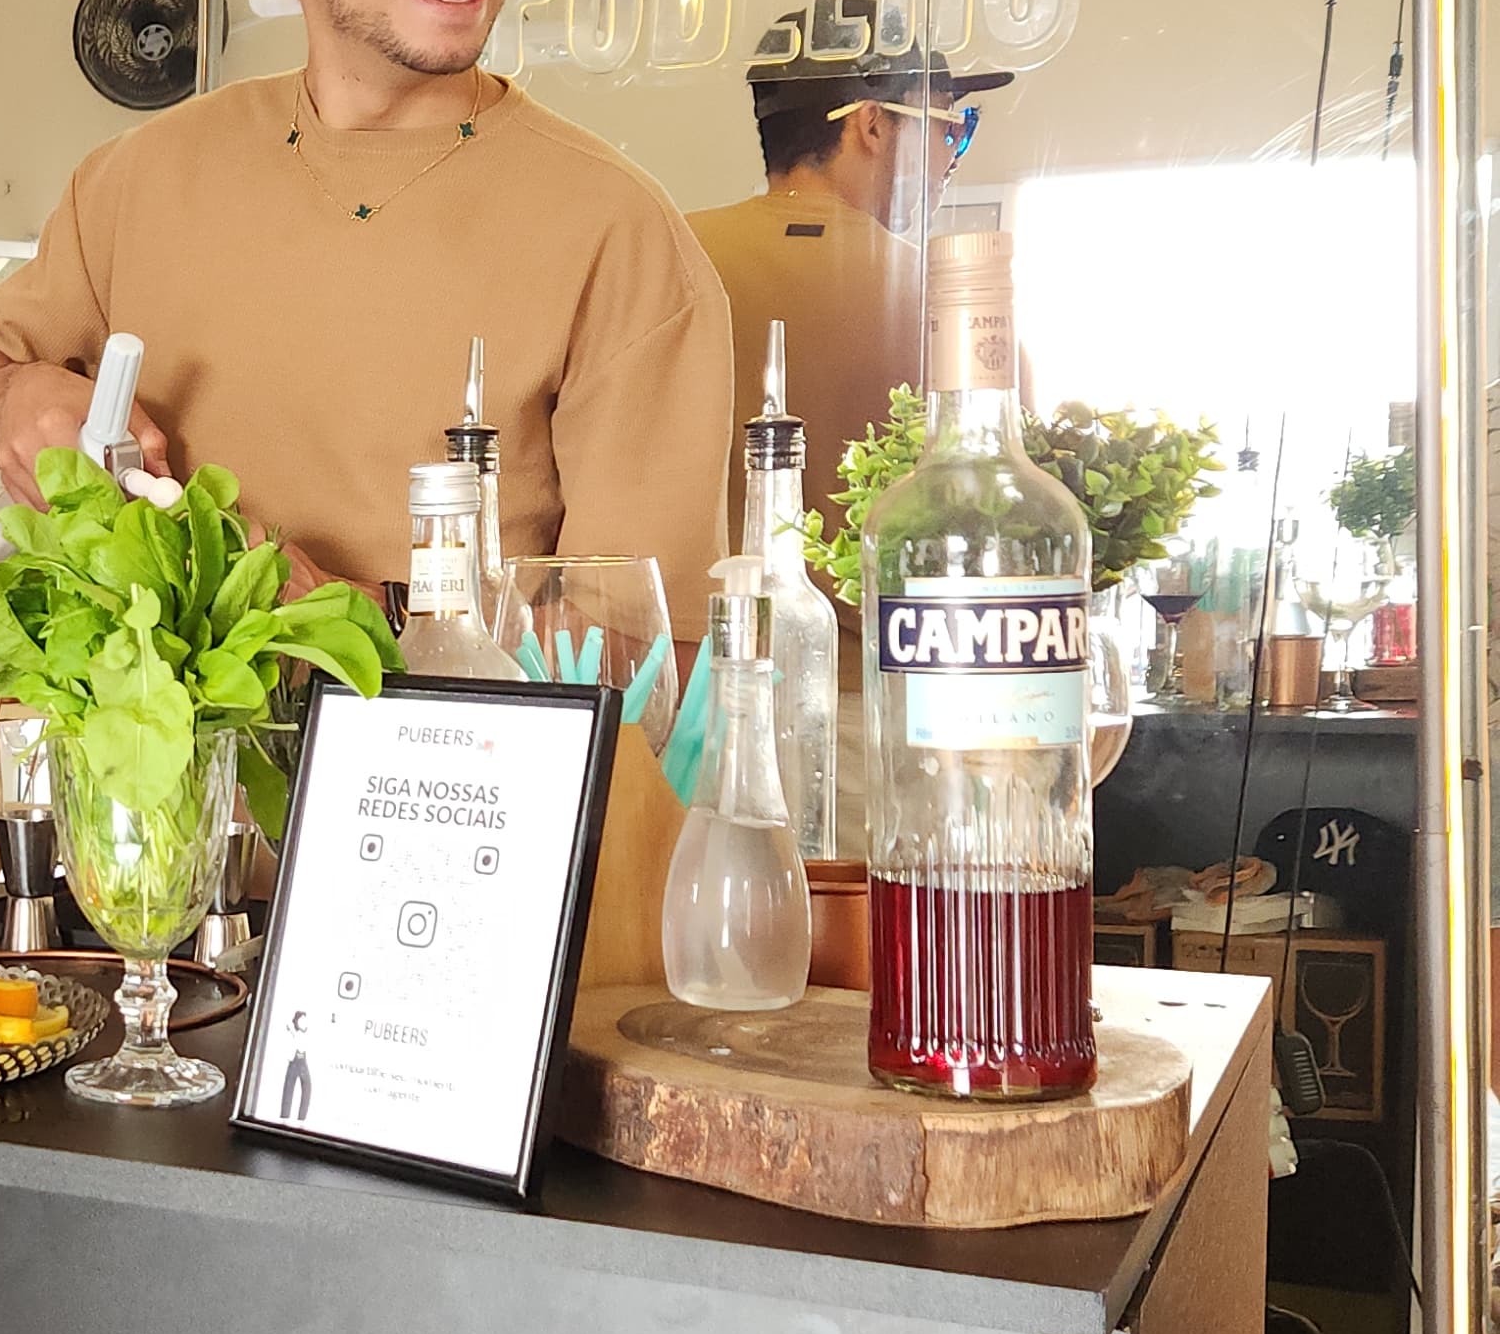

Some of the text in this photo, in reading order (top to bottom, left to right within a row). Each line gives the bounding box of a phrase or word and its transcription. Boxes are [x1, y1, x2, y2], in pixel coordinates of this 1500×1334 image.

[962, 710, 1055, 724] ILANO
[397, 725, 474, 747] PUBEERS
[366, 775, 500, 805] SIGA NOSSAS
[358, 798, 507, 829] REDES SOCIAIS
[364, 1019, 429, 1047] PUBEERS
